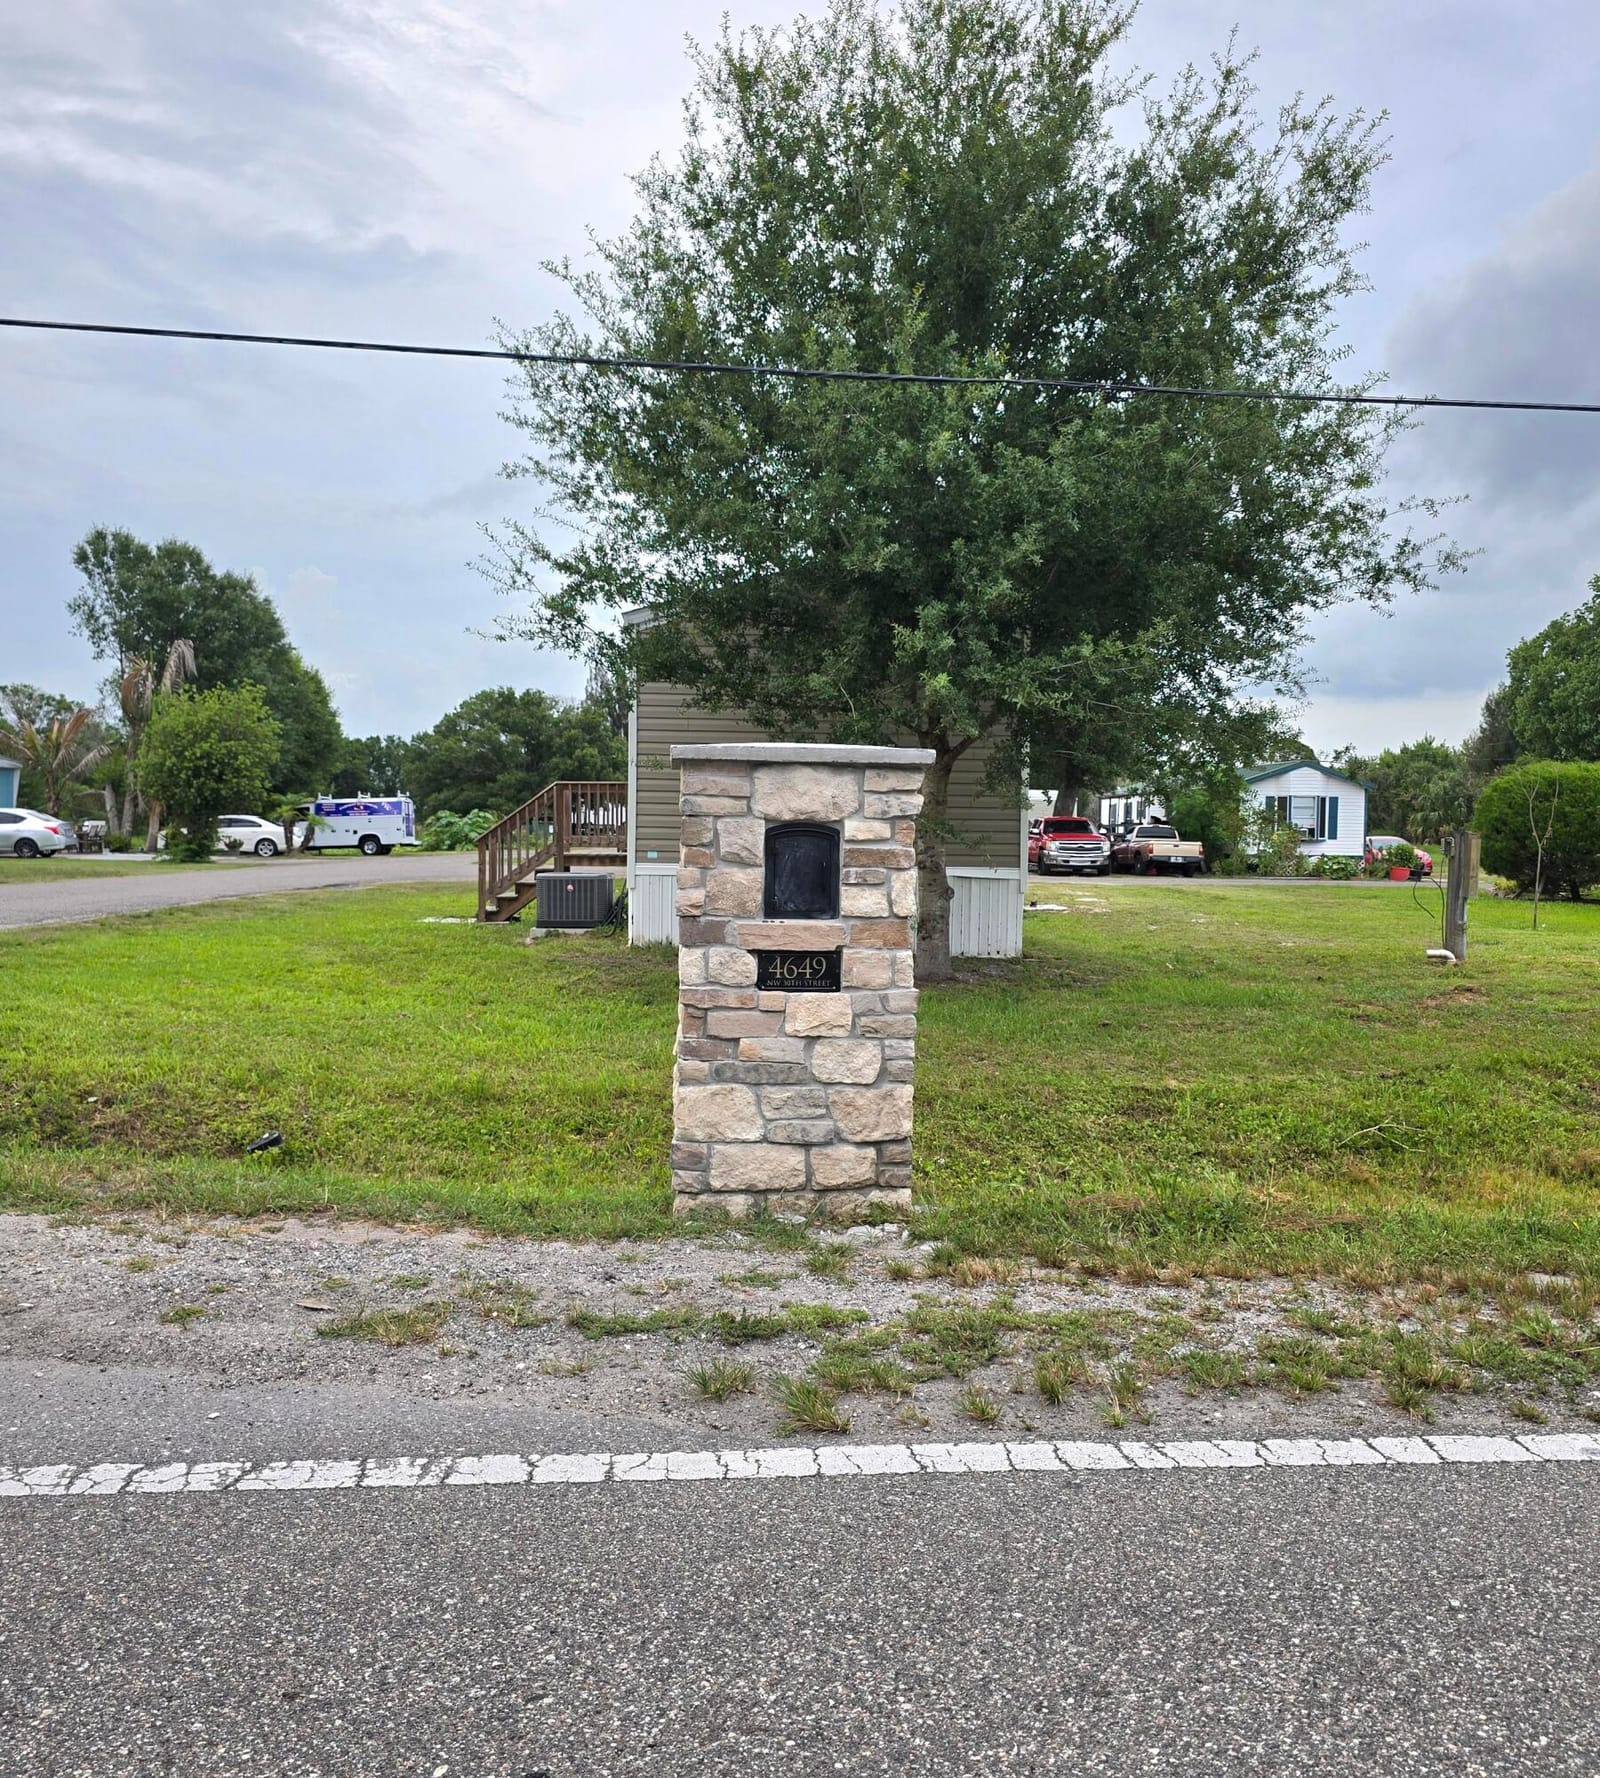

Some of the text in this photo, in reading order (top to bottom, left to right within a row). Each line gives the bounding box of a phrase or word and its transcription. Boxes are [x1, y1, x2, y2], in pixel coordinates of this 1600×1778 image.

[768, 956, 826, 979] 4649
[766, 979, 781, 987] NW
[803, 979, 831, 987] STREET
